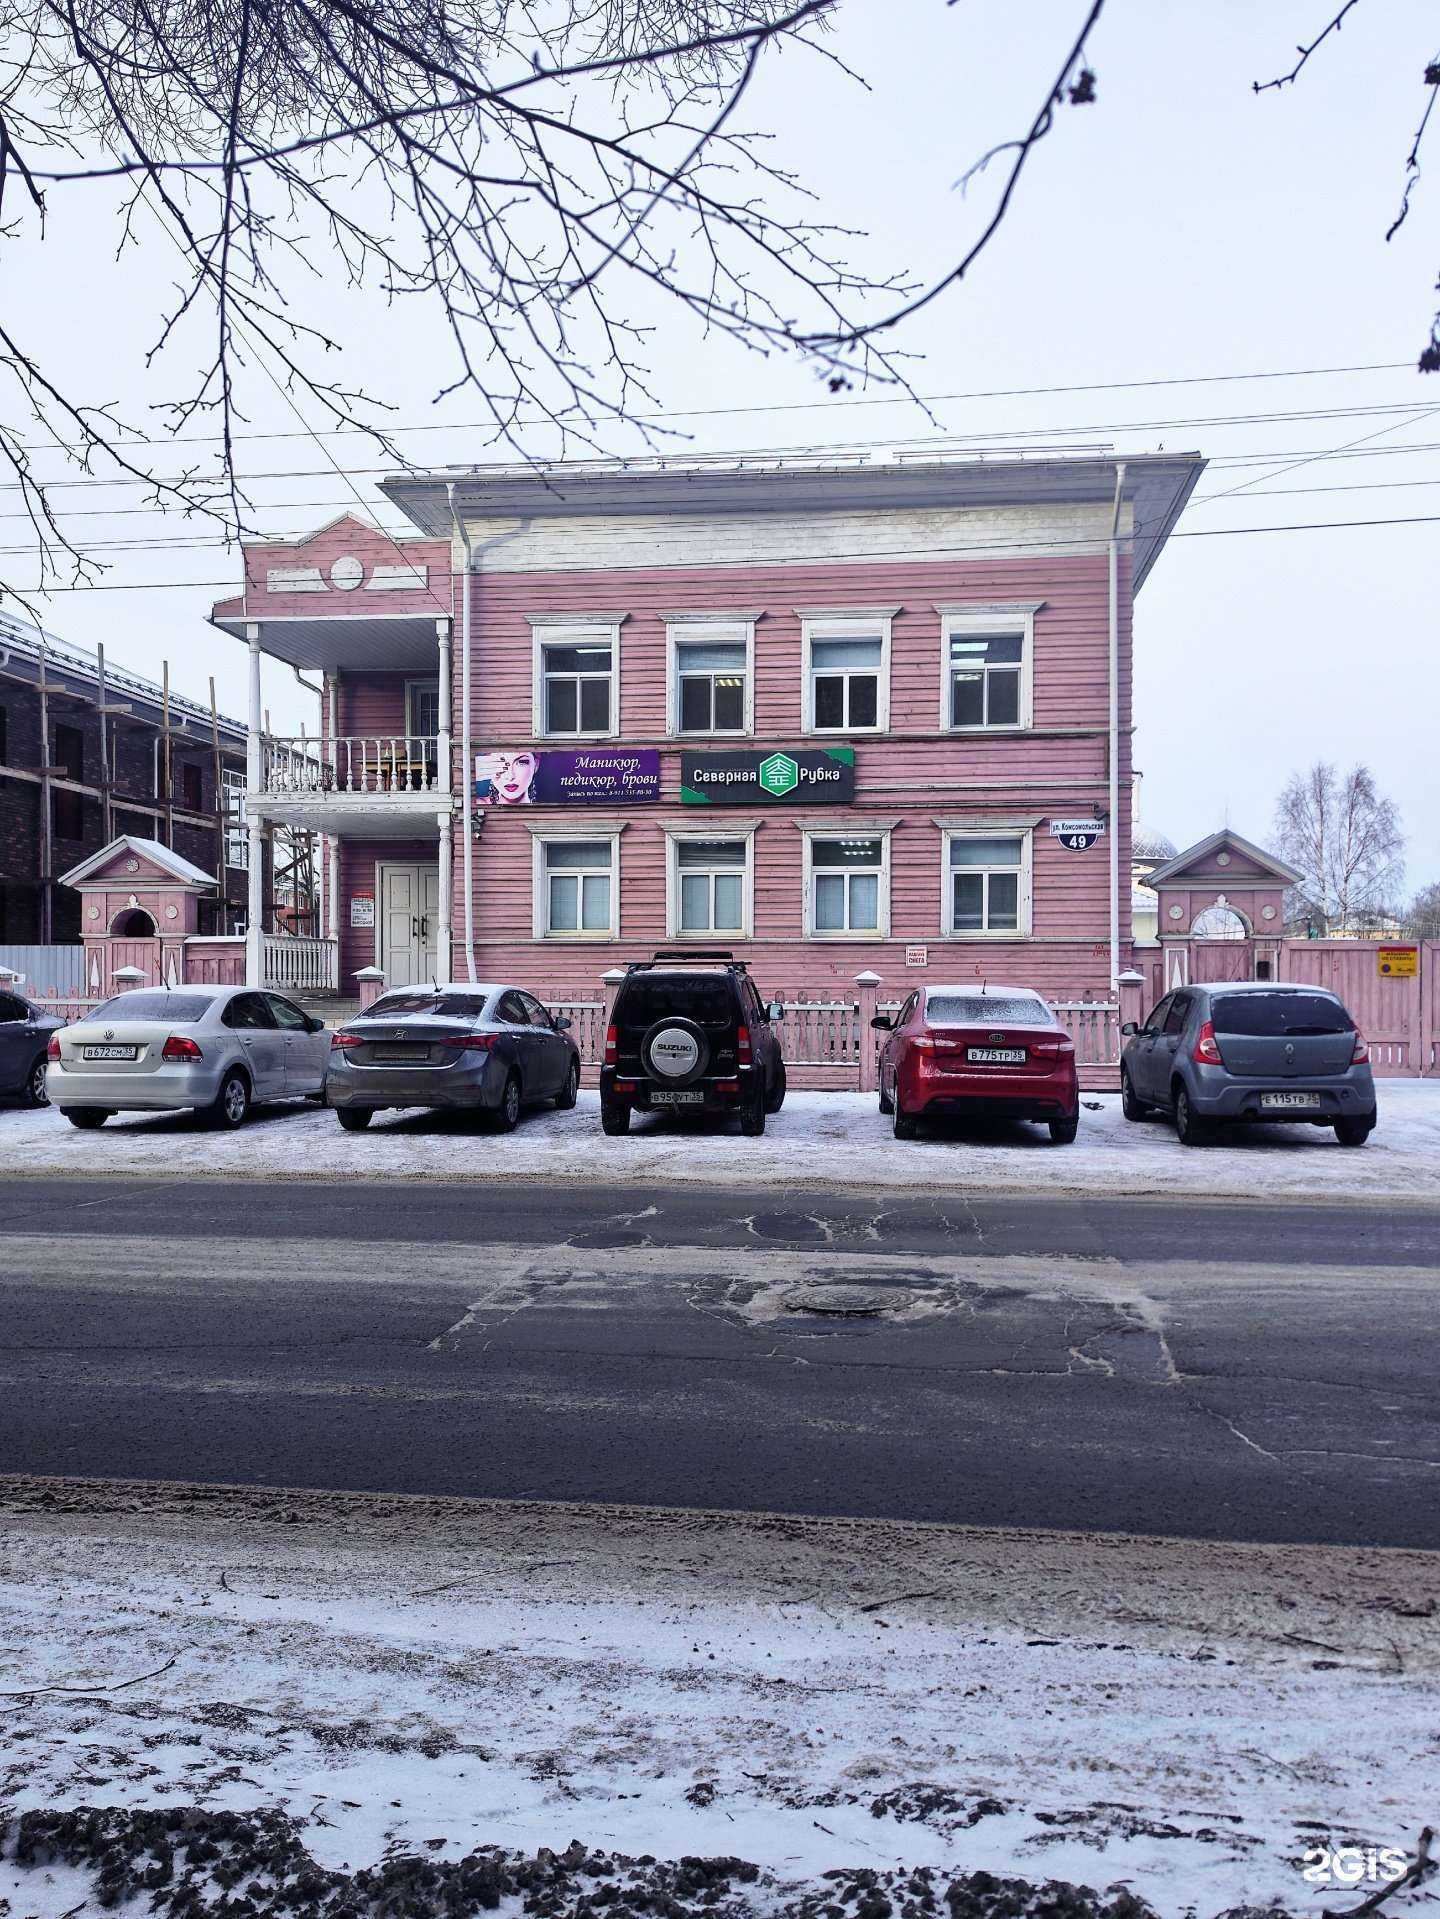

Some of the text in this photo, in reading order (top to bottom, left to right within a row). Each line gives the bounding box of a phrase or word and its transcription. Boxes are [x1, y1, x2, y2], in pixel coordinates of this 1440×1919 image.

[574, 756, 641, 771] Маникюр,
[560, 771, 658, 788] педикюр, брови
[693, 769, 757, 785] Северная
[800, 767, 840, 784] Рубка
[1061, 822, 1103, 831] Комсомольская
[1069, 835, 1086, 848] 49
[657, 1043, 692, 1052] SUZUKI
